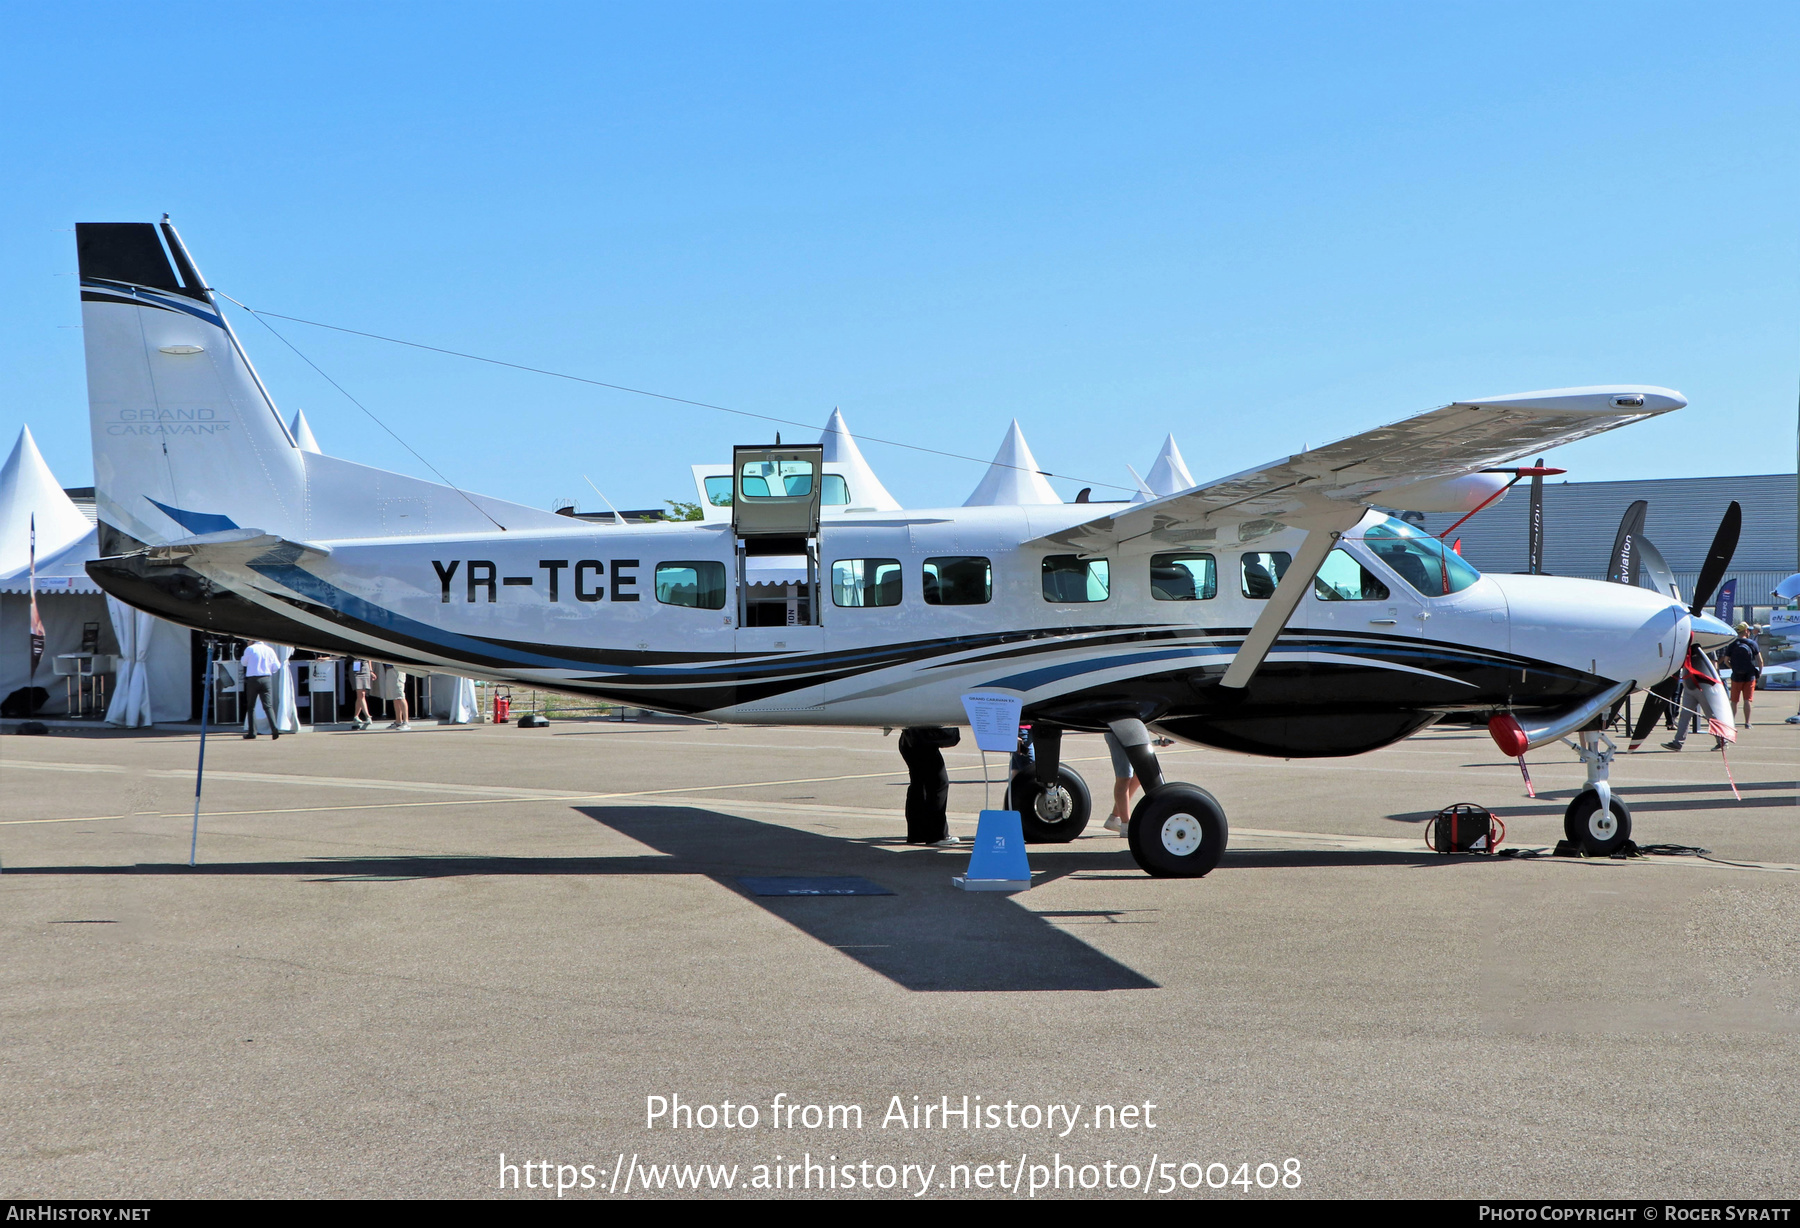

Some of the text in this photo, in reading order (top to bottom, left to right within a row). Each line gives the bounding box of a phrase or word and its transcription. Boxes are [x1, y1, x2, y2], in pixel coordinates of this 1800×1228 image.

[120, 408, 215, 421] GRAND
[106, 424, 215, 436] CARAVAN
[1619, 534, 1632, 584] aviation
[431, 559, 640, 603] YR-TCE
